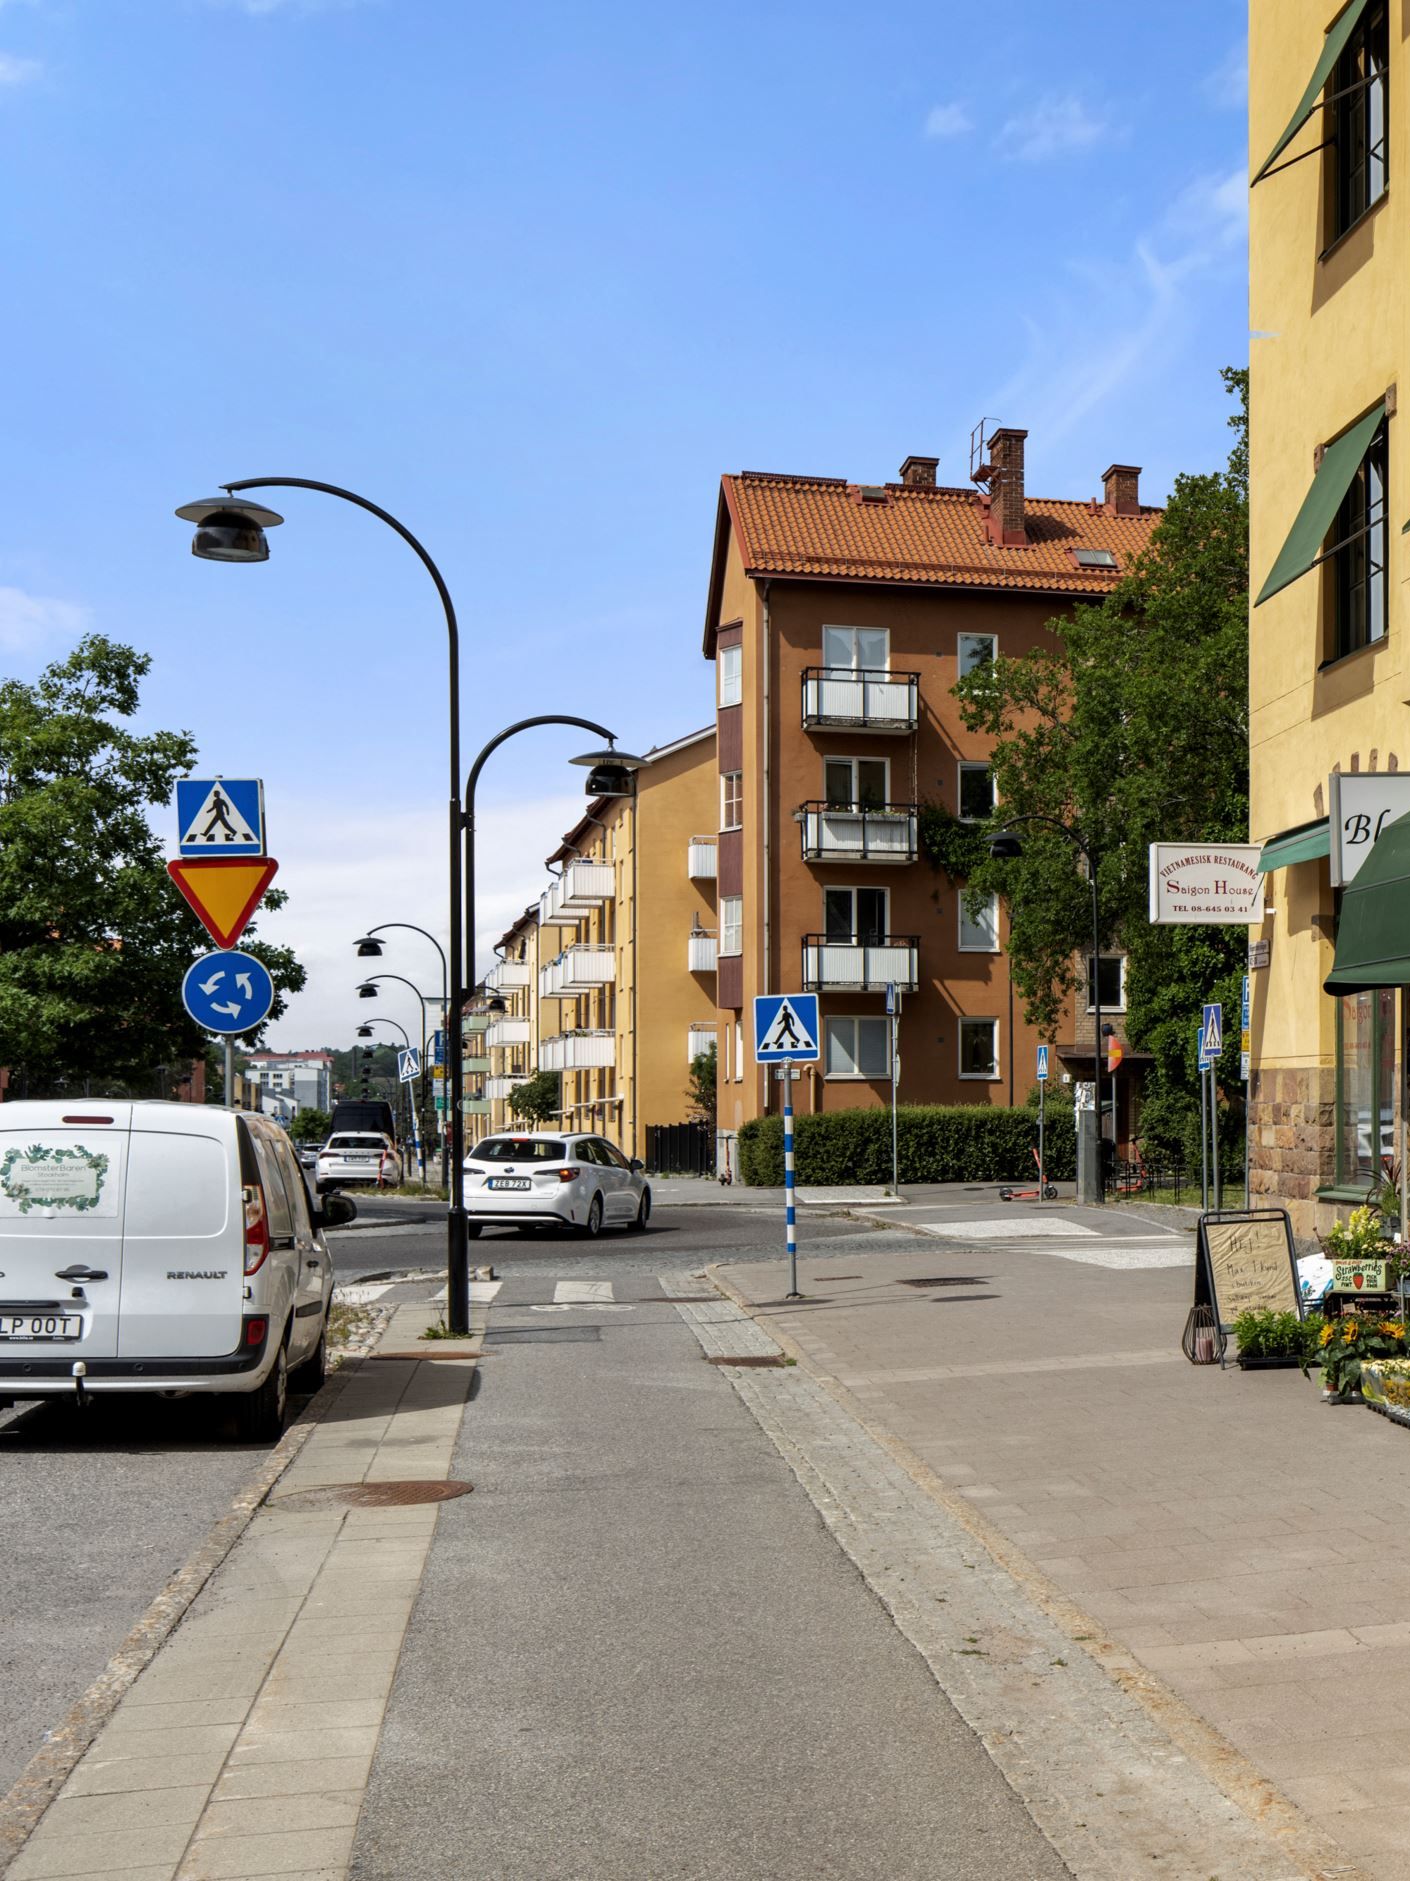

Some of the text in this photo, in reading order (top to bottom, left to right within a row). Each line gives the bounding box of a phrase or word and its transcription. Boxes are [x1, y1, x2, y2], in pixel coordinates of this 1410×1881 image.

[1344, 808, 1391, 844] Bl
[1160, 855, 1259, 880] VIETNAMESISK RESTAURANG
[1166, 880, 1254, 896] Saigon House
[1191, 905, 1222, 913] 08-645
[166, 1271, 228, 1280] RENAULT
[1335, 1262, 1382, 1280] Strawberries
